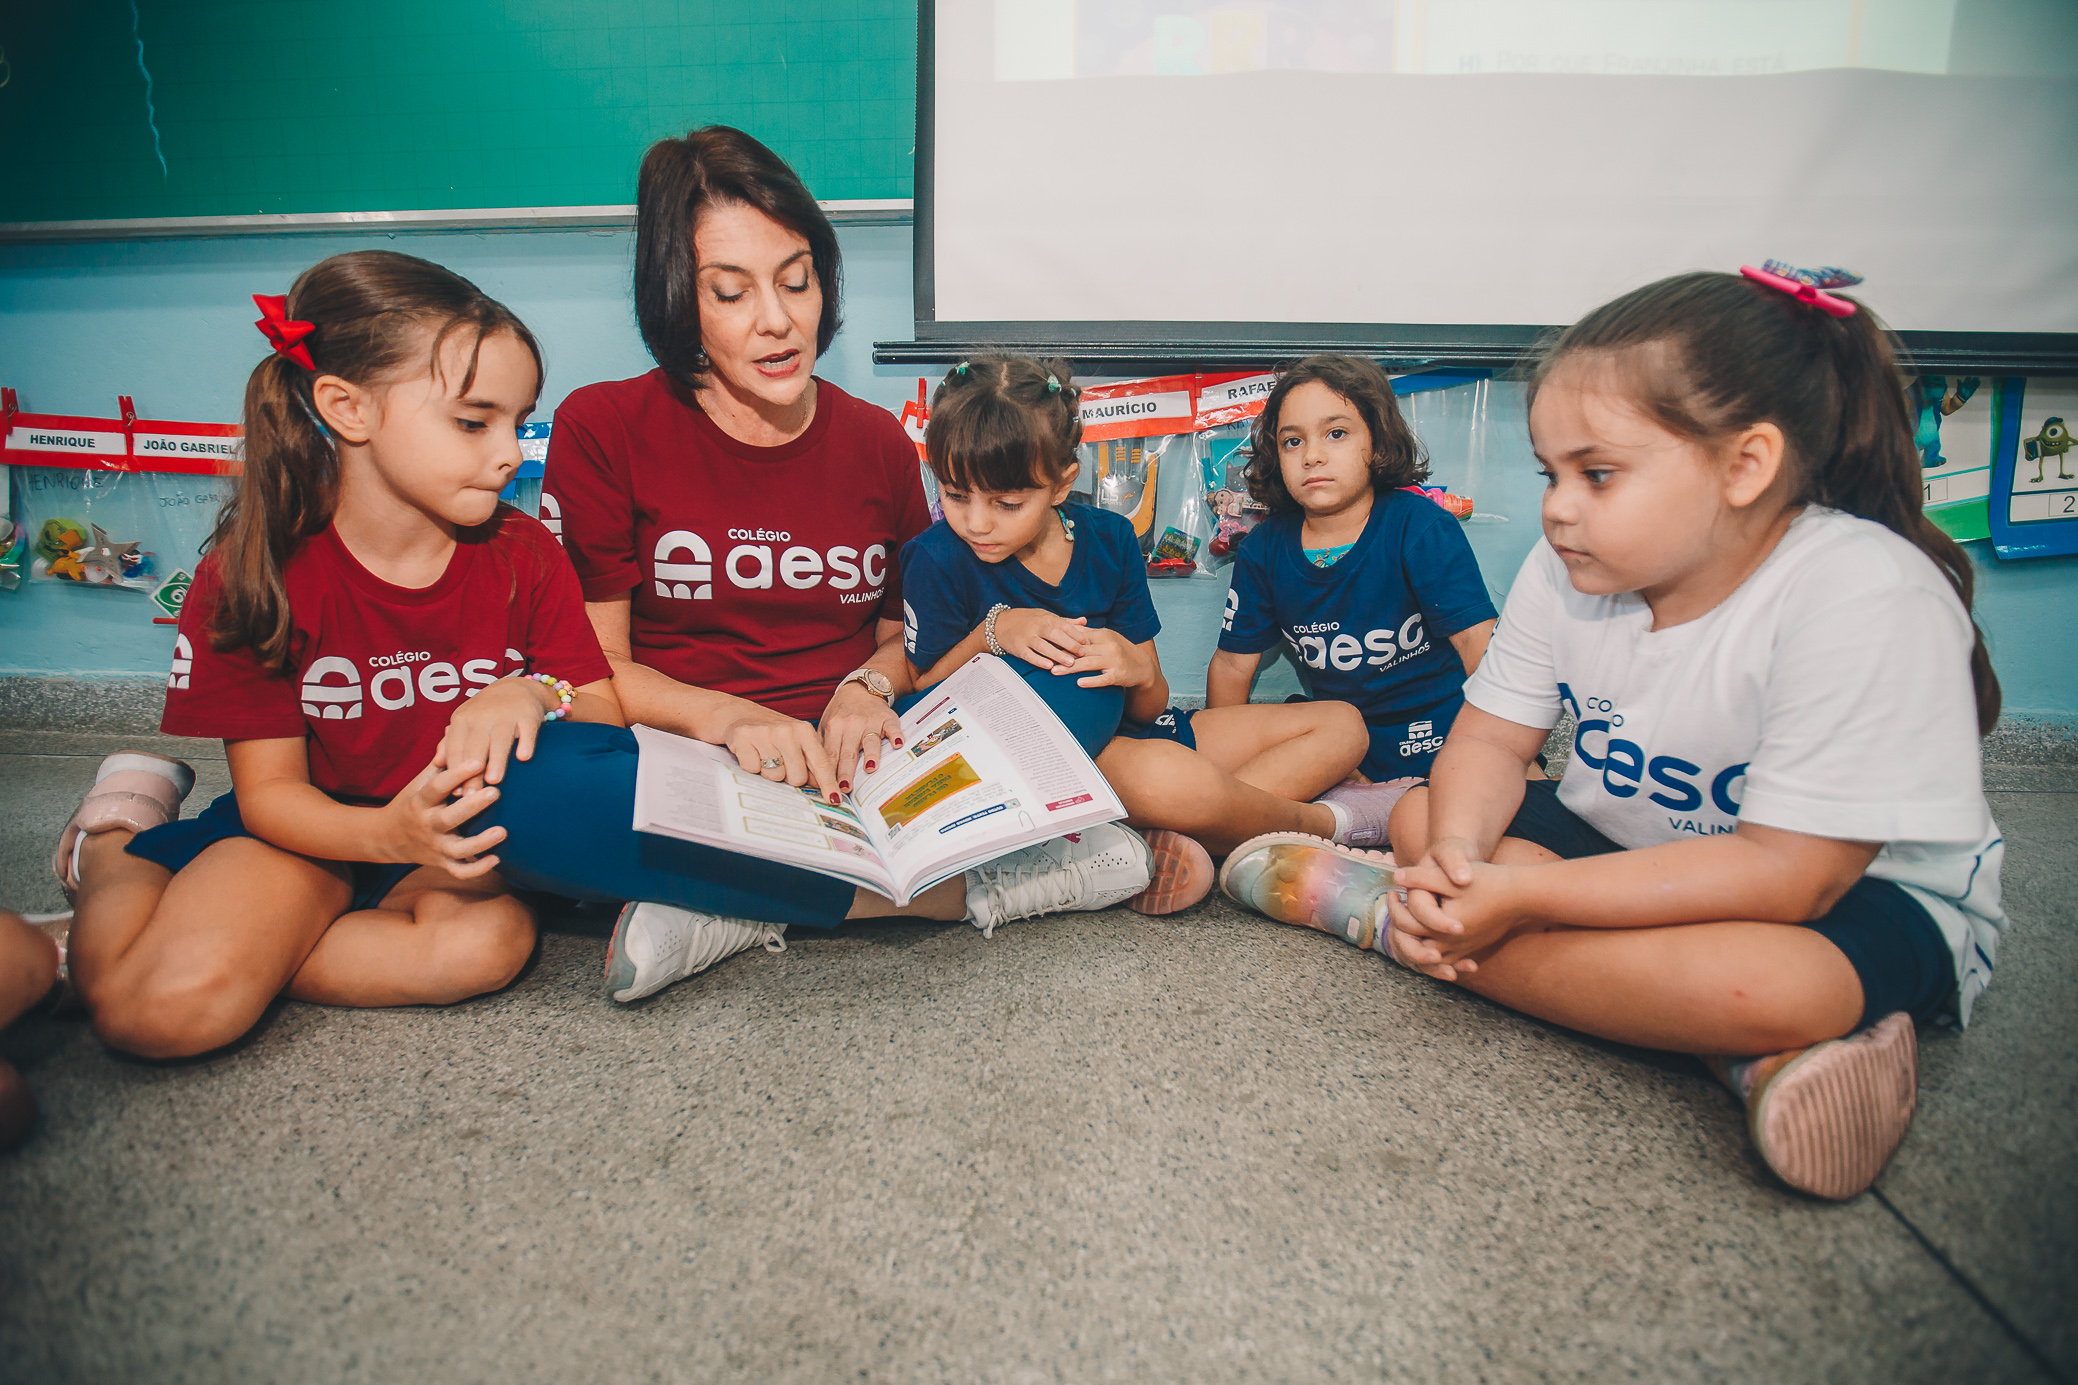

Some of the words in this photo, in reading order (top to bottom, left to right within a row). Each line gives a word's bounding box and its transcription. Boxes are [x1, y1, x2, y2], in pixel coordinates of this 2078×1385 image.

[1227, 381, 1276, 399] RAFAE
[1082, 402, 1157, 419] MAURÍCIO
[30, 434, 96, 448] HENRIQUE
[143, 439, 177, 451] JOÃO
[180, 442, 237, 455] GABRIEL
[2063, 495, 2076, 513] 2
[727, 528, 791, 542] COLÉGIO
[725, 544, 886, 589] aesc
[1293, 621, 1340, 634] COLÉGIO
[1299, 612, 1424, 671] aesc
[368, 651, 431, 668] COLÉGIO
[1379, 641, 1431, 672] VALINHOS
[1400, 736, 1443, 757] aesc
[1669, 817, 1734, 836] VALIN
